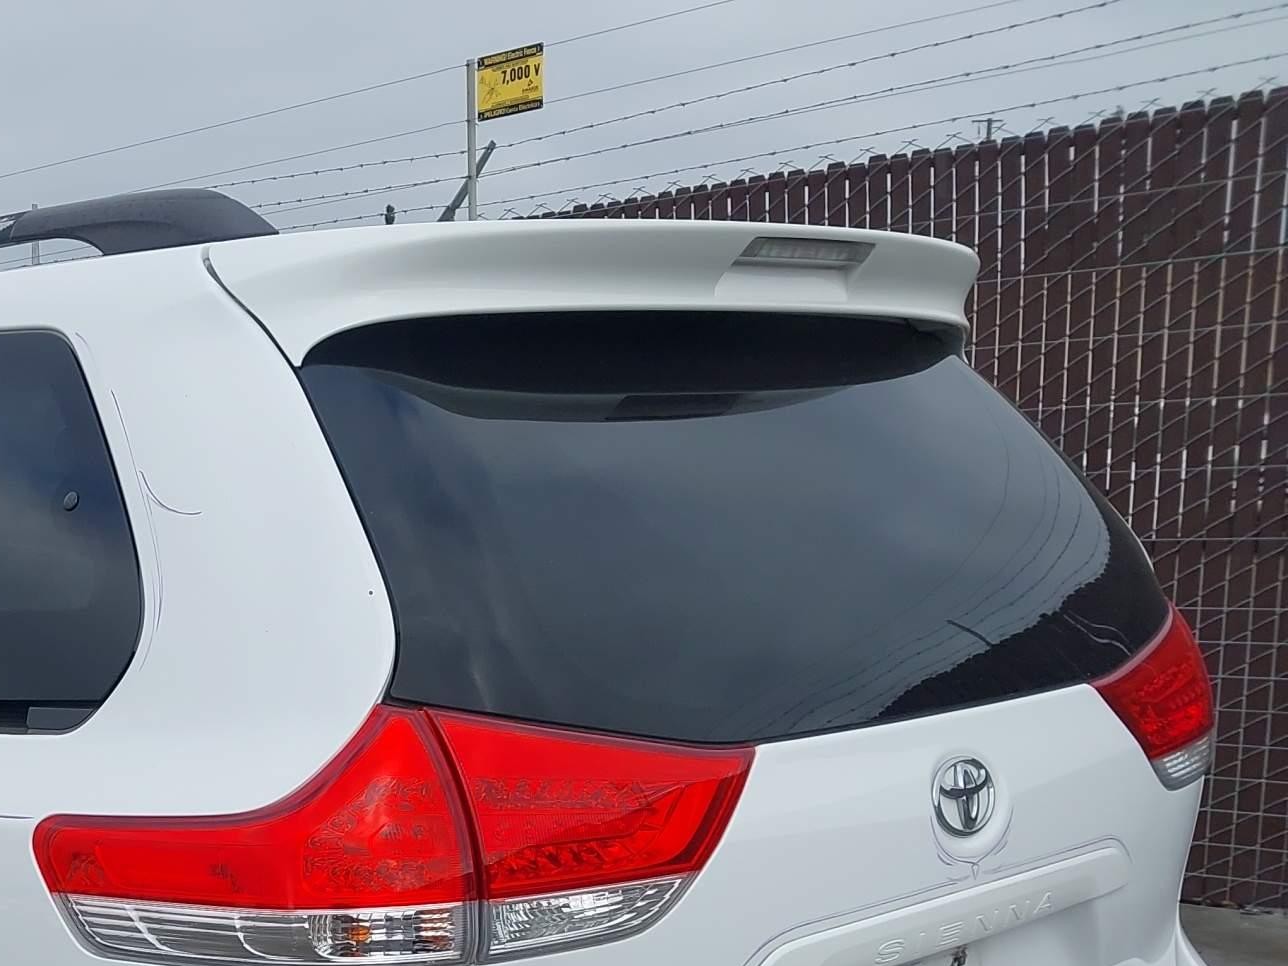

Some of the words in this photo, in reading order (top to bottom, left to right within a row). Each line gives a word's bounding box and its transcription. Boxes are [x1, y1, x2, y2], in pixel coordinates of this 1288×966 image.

[501, 64, 531, 85] 7,000
[533, 63, 541, 76] V
[874, 892, 1053, 966] SIENNA
